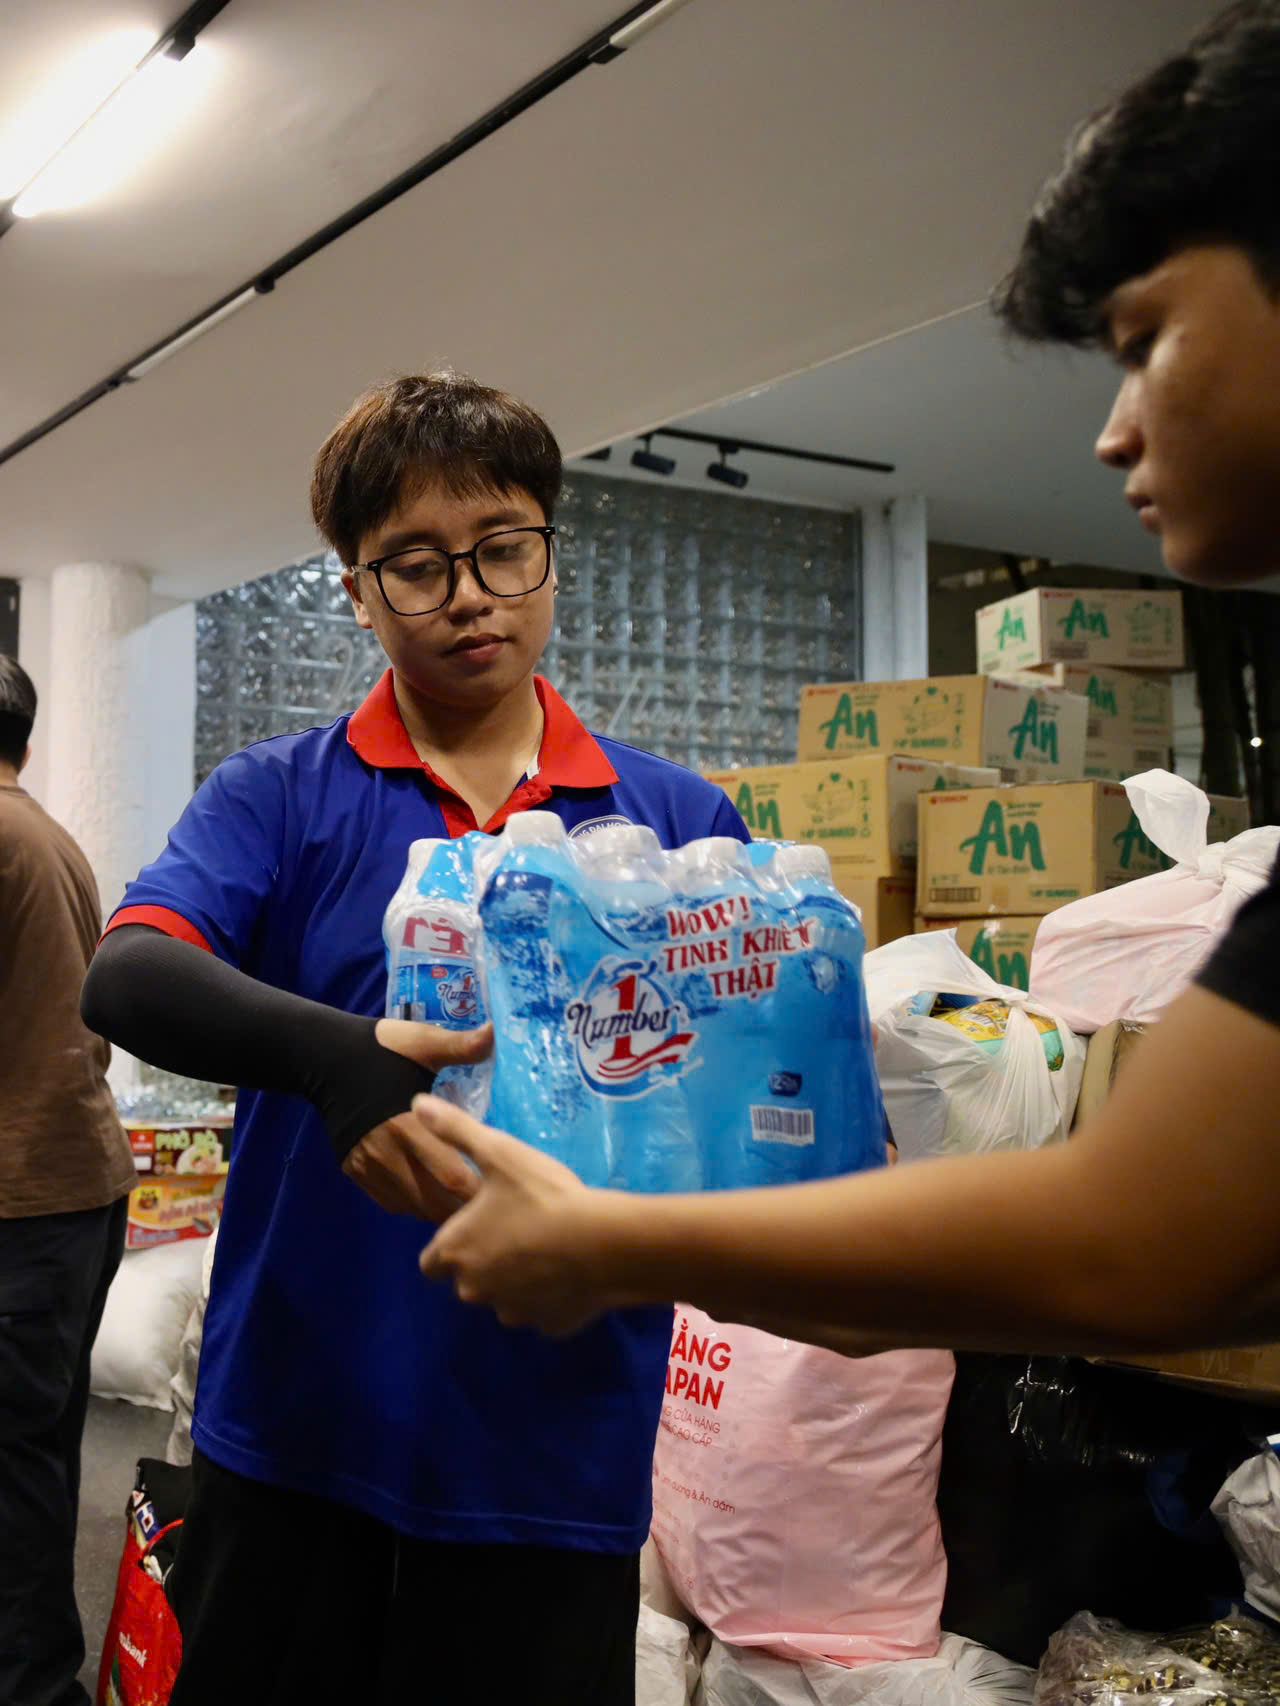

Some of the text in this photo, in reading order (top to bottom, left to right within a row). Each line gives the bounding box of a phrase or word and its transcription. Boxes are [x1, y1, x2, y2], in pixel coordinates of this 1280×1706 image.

[995, 607, 1026, 651] An
[1057, 597, 1110, 639] An
[818, 692, 880, 750] An
[1008, 696, 1060, 765] An
[736, 782, 783, 839] An
[959, 799, 1047, 876] An
[662, 937, 729, 973] TINH
[709, 956, 777, 999] THẬT
[567, 991, 681, 1050] Number
[671, 1317, 732, 1373] ẰNG
